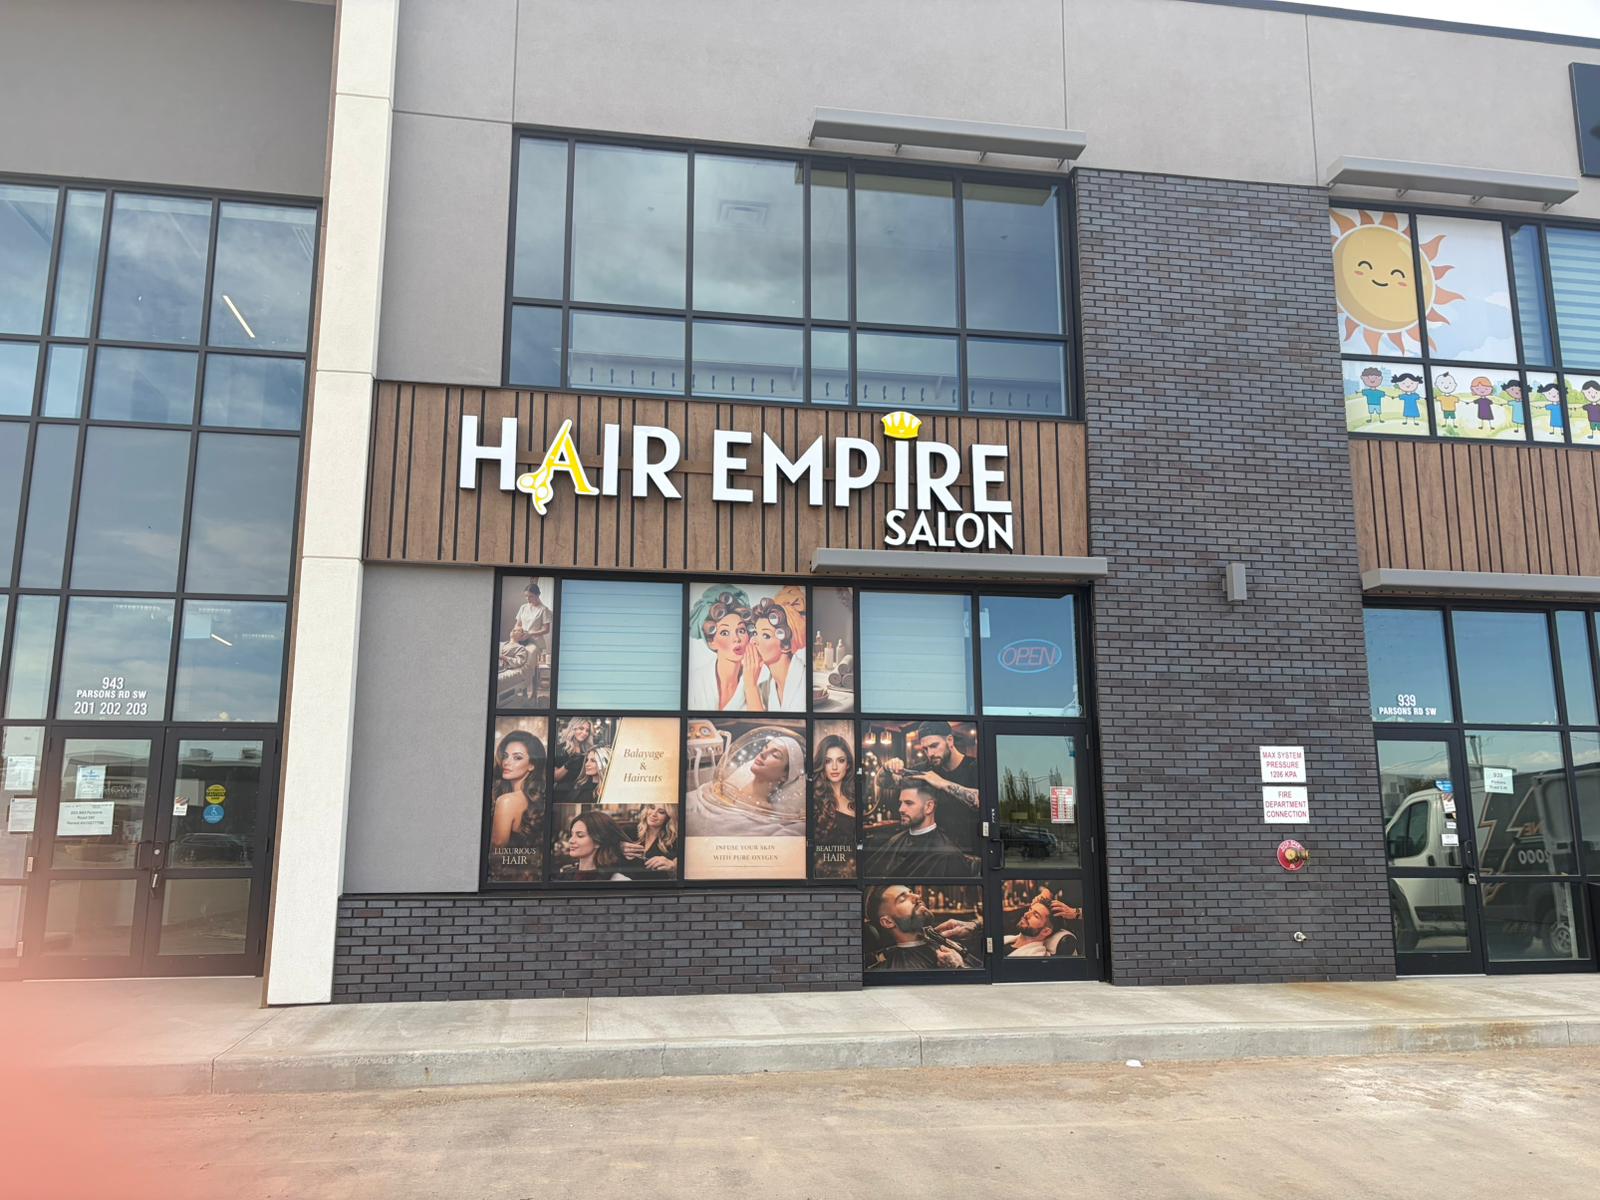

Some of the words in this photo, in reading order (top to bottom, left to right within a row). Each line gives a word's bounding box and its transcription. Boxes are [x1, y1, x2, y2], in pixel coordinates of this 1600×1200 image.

[459, 415, 682, 515] HAIR
[712, 428, 1013, 513] EMPIRE
[884, 509, 1014, 550] SALON
[1002, 647, 1057, 666] OPEN
[102, 676, 124, 690] 943
[76, 689, 116, 699] PARSONS
[118, 690, 130, 699] RD
[132, 690, 147, 699] SW
[1397, 694, 1417, 707] 939
[74, 701, 95, 715] 201
[99, 702, 121, 715] 202
[126, 702, 148, 716] 203
[1378, 706, 1412, 716] PARSONS
[1413, 707, 1424, 716] RD
[1425, 707, 1437, 716] SW
[623, 748, 665, 761] Balayage
[1262, 751, 1276, 759] MAX
[1277, 751, 1302, 760] SYSTEM
[640, 761, 647, 771] &
[1265, 761, 1300, 769] PRESSURE
[623, 772, 663, 783] Haircuts
[1284, 770, 1298, 778] KPA
[1278, 790, 1292, 799] FIRE
[1265, 800, 1307, 809] DEPARTMENT
[1266, 810, 1307, 818] CONNECTION
[494, 847, 537, 855] LUXURIOUS
[815, 844, 853, 852] BEAUTIFUL
[502, 855, 528, 865] HAIR
[823, 852, 847, 862] HAIR
